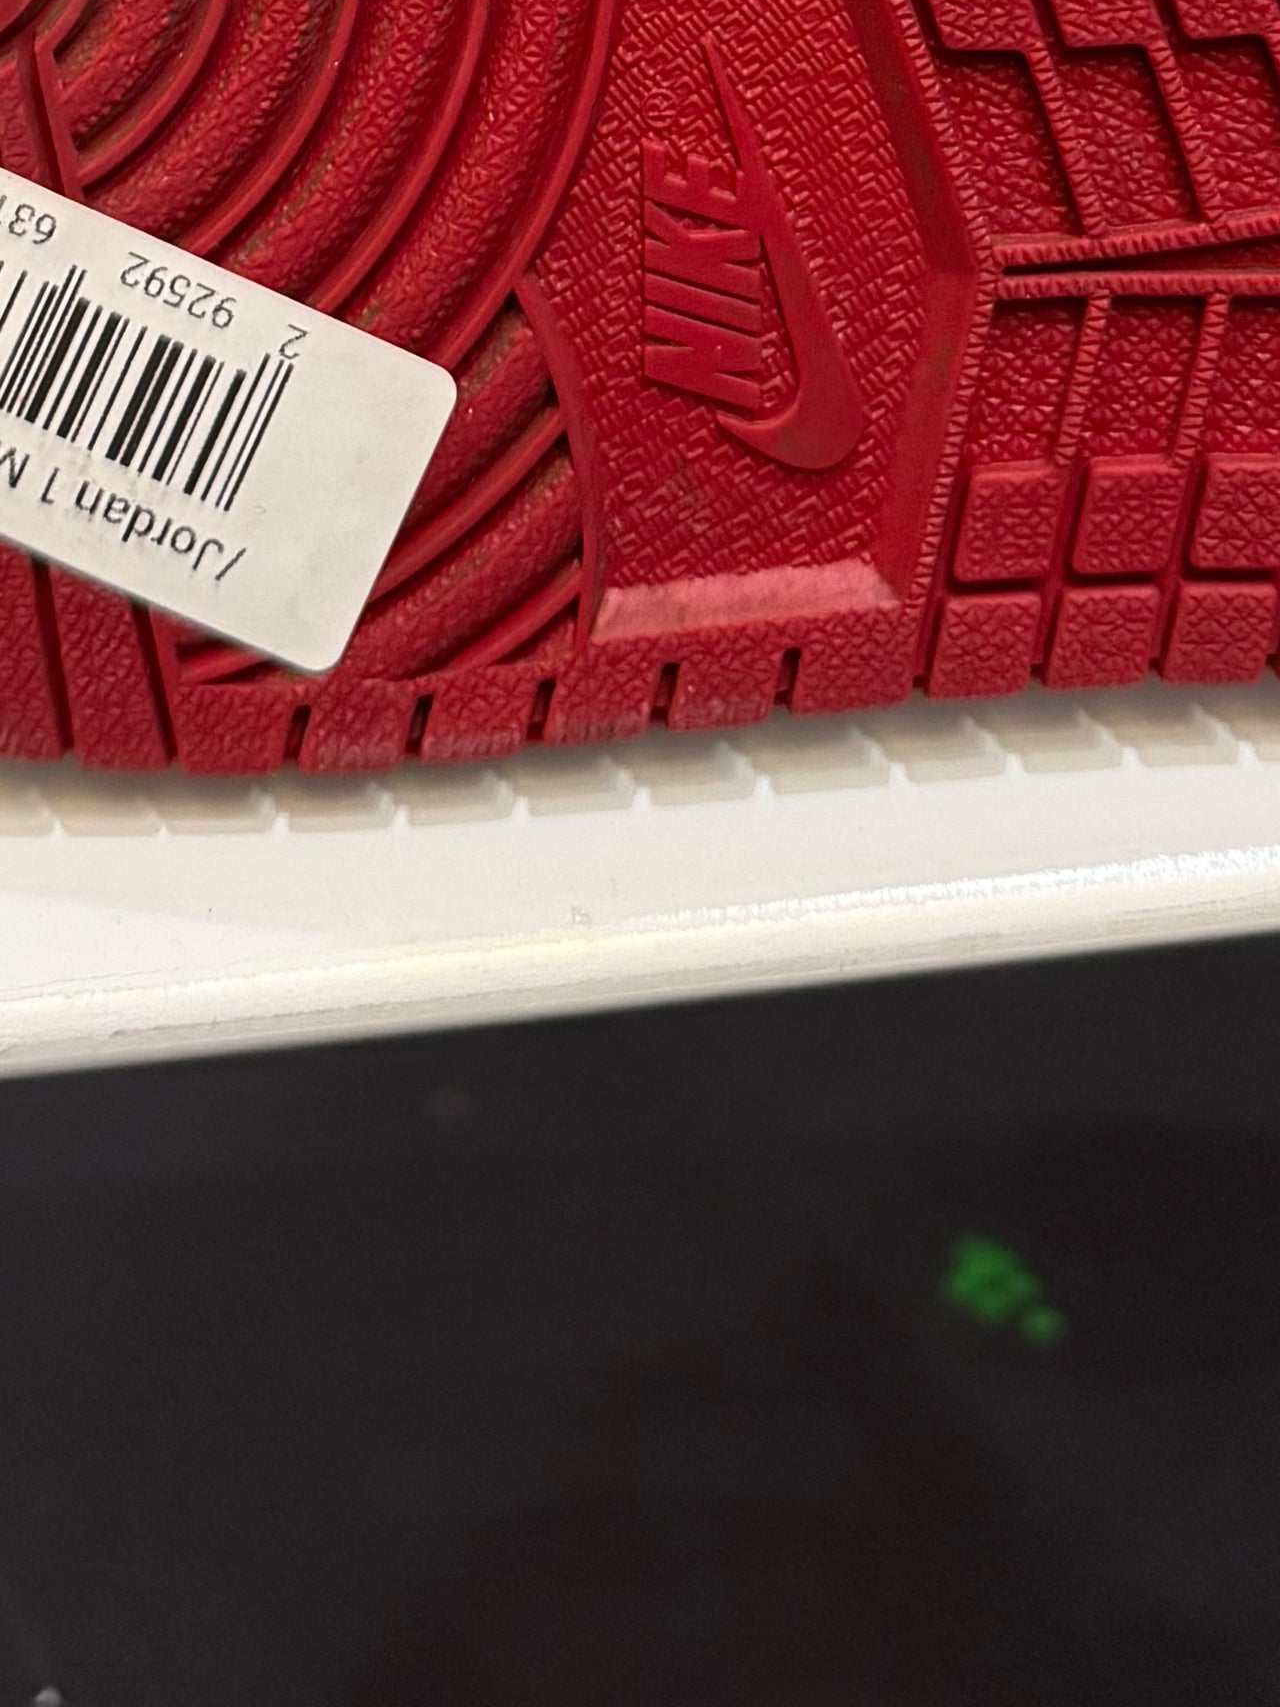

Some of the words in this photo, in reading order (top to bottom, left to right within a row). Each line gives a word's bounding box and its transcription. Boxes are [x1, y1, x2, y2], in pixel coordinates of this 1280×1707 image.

[120, 252, 237, 329] 92592
[643, 138, 761, 410] NIKE
[278, 323, 308, 360] 2
[40, 467, 60, 505] 1
[74, 480, 248, 582] /Jordan
